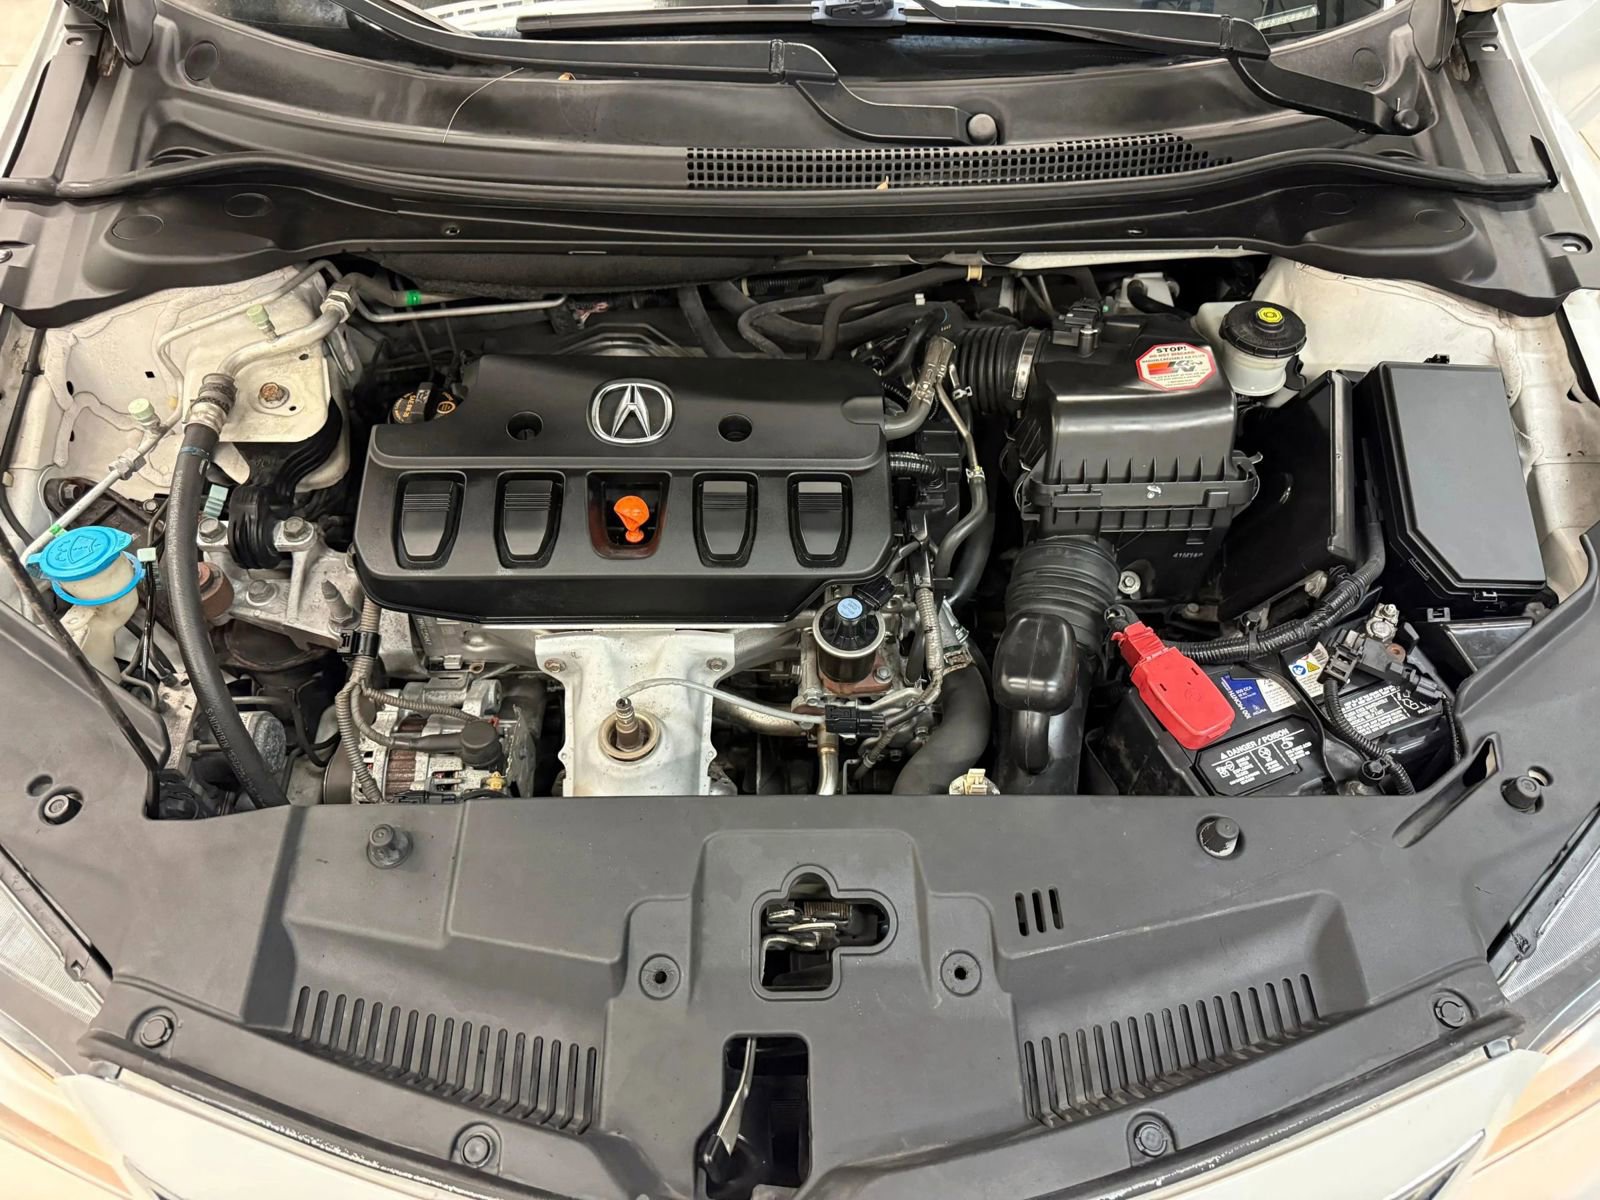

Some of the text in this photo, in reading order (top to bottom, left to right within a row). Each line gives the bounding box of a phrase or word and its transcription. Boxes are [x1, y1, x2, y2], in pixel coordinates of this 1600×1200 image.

[1228, 690, 1246, 710] MONTH
[1226, 740, 1258, 757] DANGER
[1261, 727, 1290, 743] POISON
